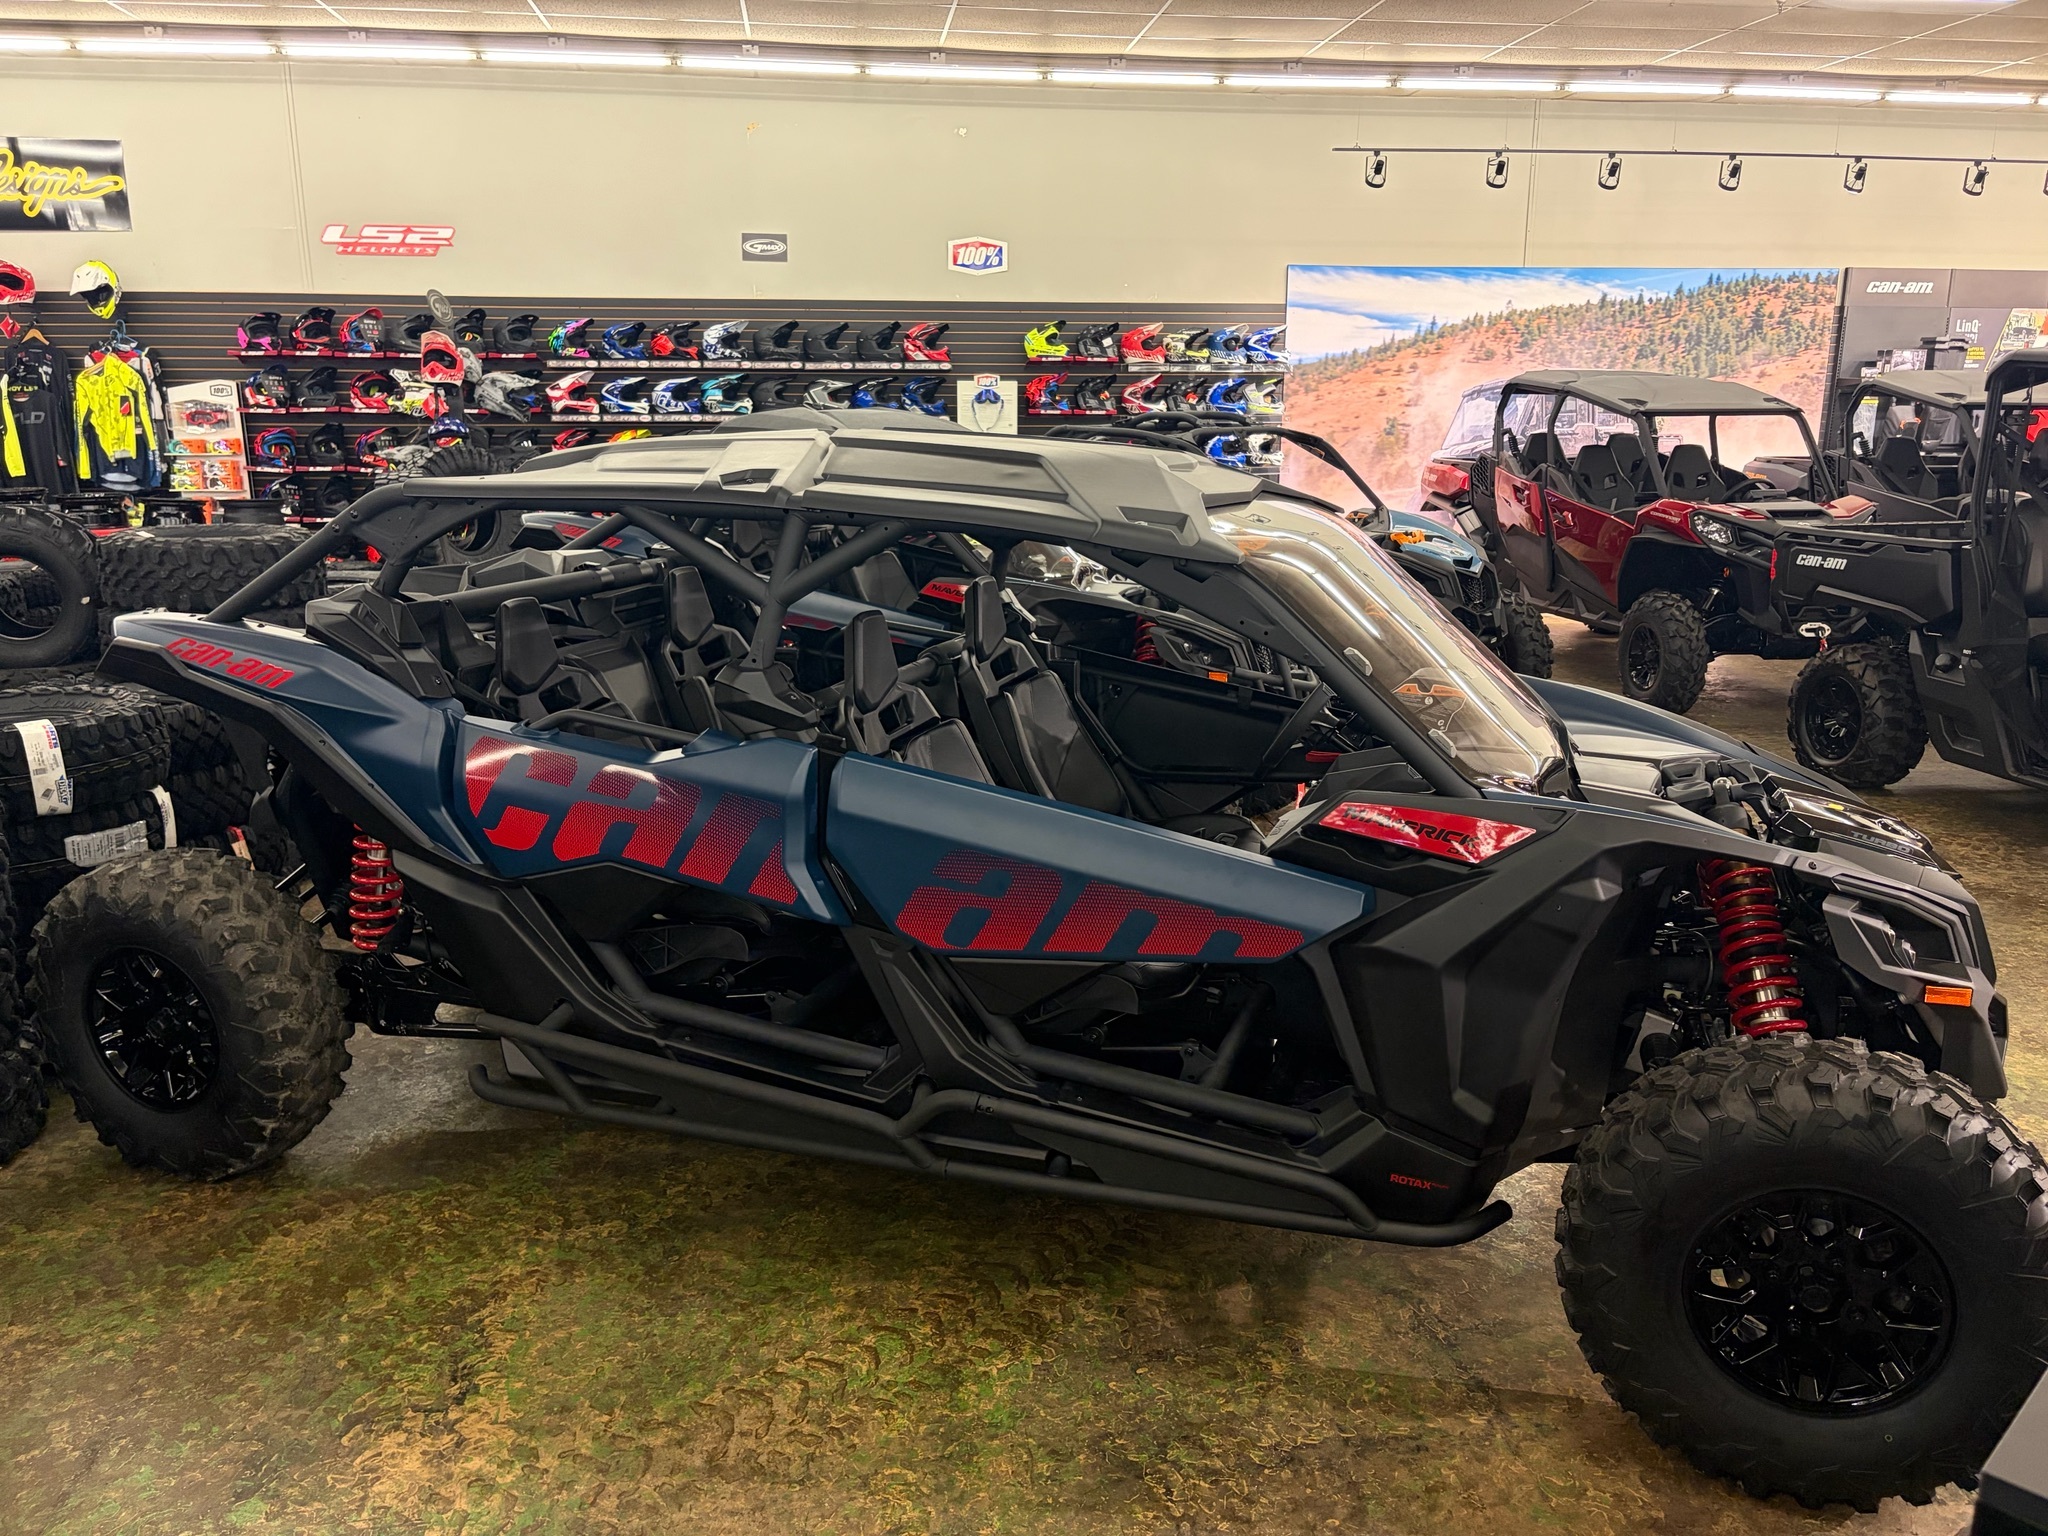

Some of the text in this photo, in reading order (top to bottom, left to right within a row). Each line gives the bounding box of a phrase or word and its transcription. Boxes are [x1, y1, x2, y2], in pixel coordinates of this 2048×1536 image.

[320, 224, 456, 245] LS2
[336, 245, 436, 254] HELMETS
[956, 246, 1000, 266] 100%
[1866, 281, 1934, 294] can-am
[1955, 319, 1979, 333] LinQ
[1796, 553, 1847, 570] can-am
[166, 637, 295, 689] can-am
[1341, 806, 1480, 850] MAVERICK
[1850, 830, 1911, 854] TURBO
[1389, 1173, 1432, 1189] ROTAX
